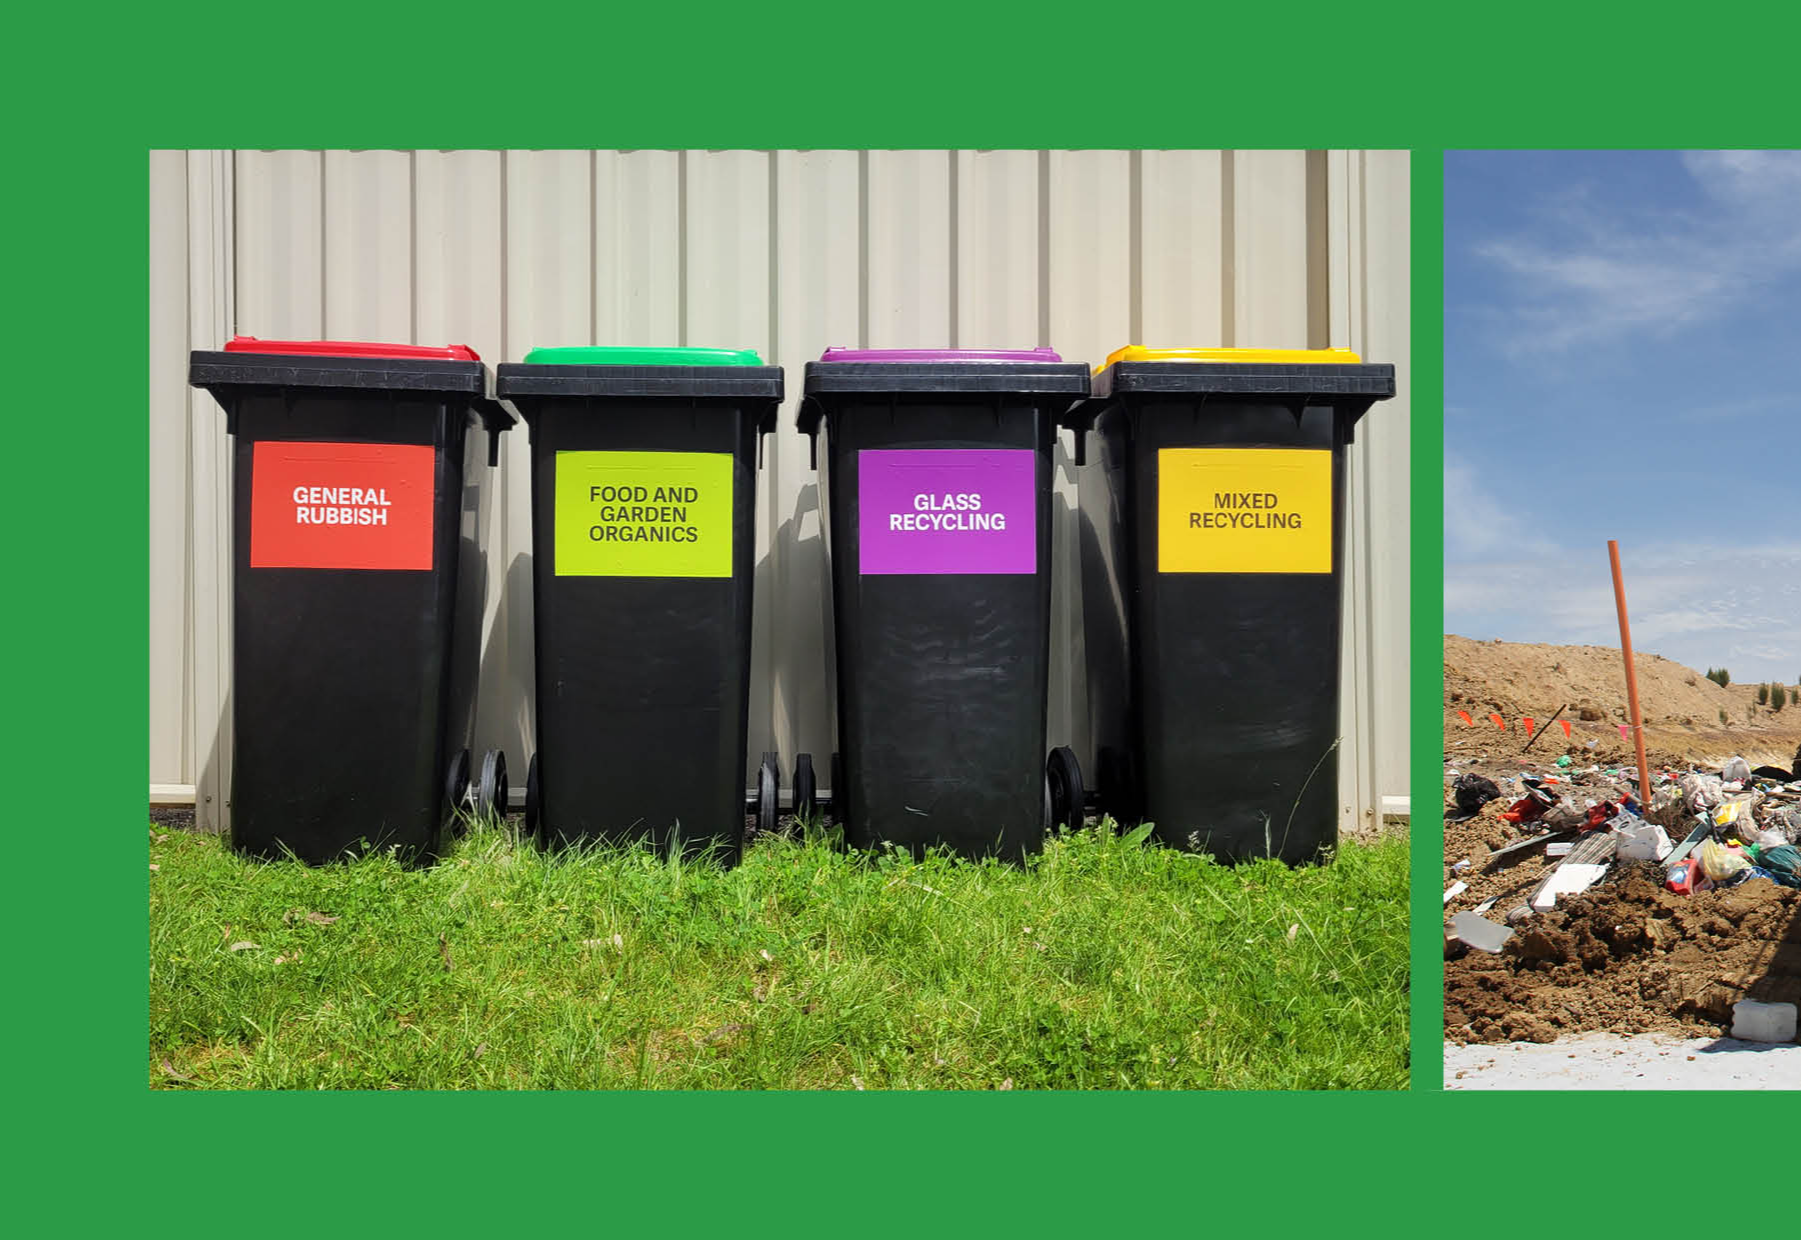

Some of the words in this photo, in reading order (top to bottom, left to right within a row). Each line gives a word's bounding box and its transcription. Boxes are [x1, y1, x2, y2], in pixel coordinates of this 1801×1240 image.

[293, 486, 392, 506] GENERAL
[590, 486, 648, 502] FOOD
[653, 487, 698, 503] AND
[913, 493, 982, 511] GLASS
[1214, 493, 1278, 509] MIXED
[296, 506, 388, 526] RUBBISH
[600, 505, 687, 522] GARDEN
[889, 513, 1006, 531] RECYCLING
[1189, 512, 1302, 529] RECYCLING
[589, 525, 698, 542] ORGANICS
